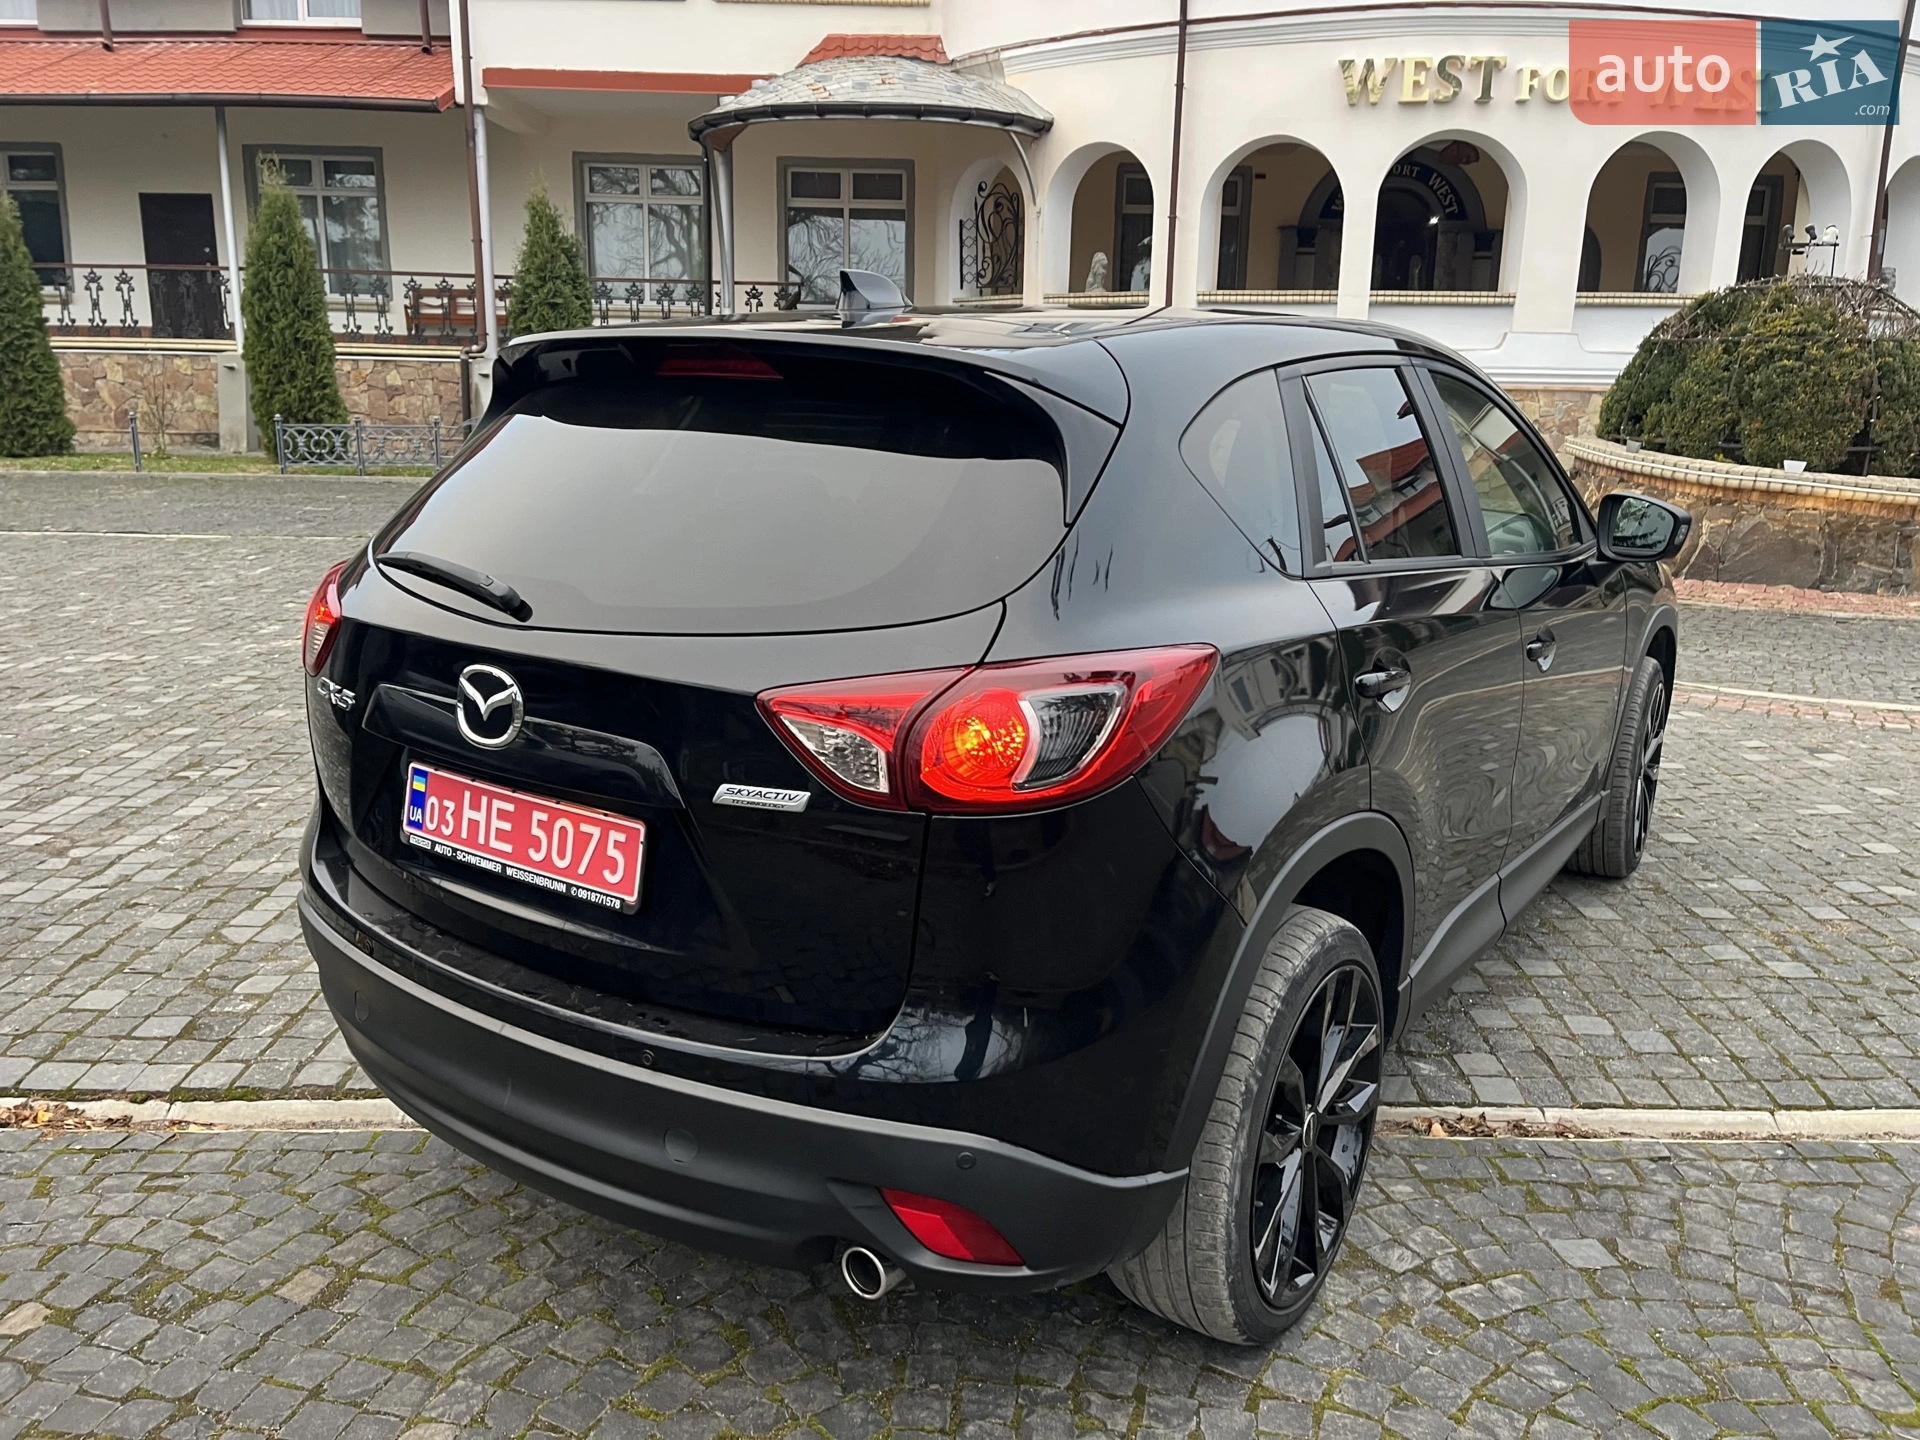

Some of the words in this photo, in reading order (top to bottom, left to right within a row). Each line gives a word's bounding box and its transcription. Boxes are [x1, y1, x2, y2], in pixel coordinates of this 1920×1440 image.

[1338, 54, 1508, 106] WEST
[1391, 164, 1421, 178] ORT
[1428, 172, 1459, 215] WEST
[317, 676, 356, 711] CX-5
[724, 787, 800, 801] SKYACTIV
[731, 799, 787, 809] TECHNOLOGY
[409, 805, 423, 824] UA
[528, 810, 627, 884] 5075
[506, 866, 567, 893] WEISSENBRUNN
